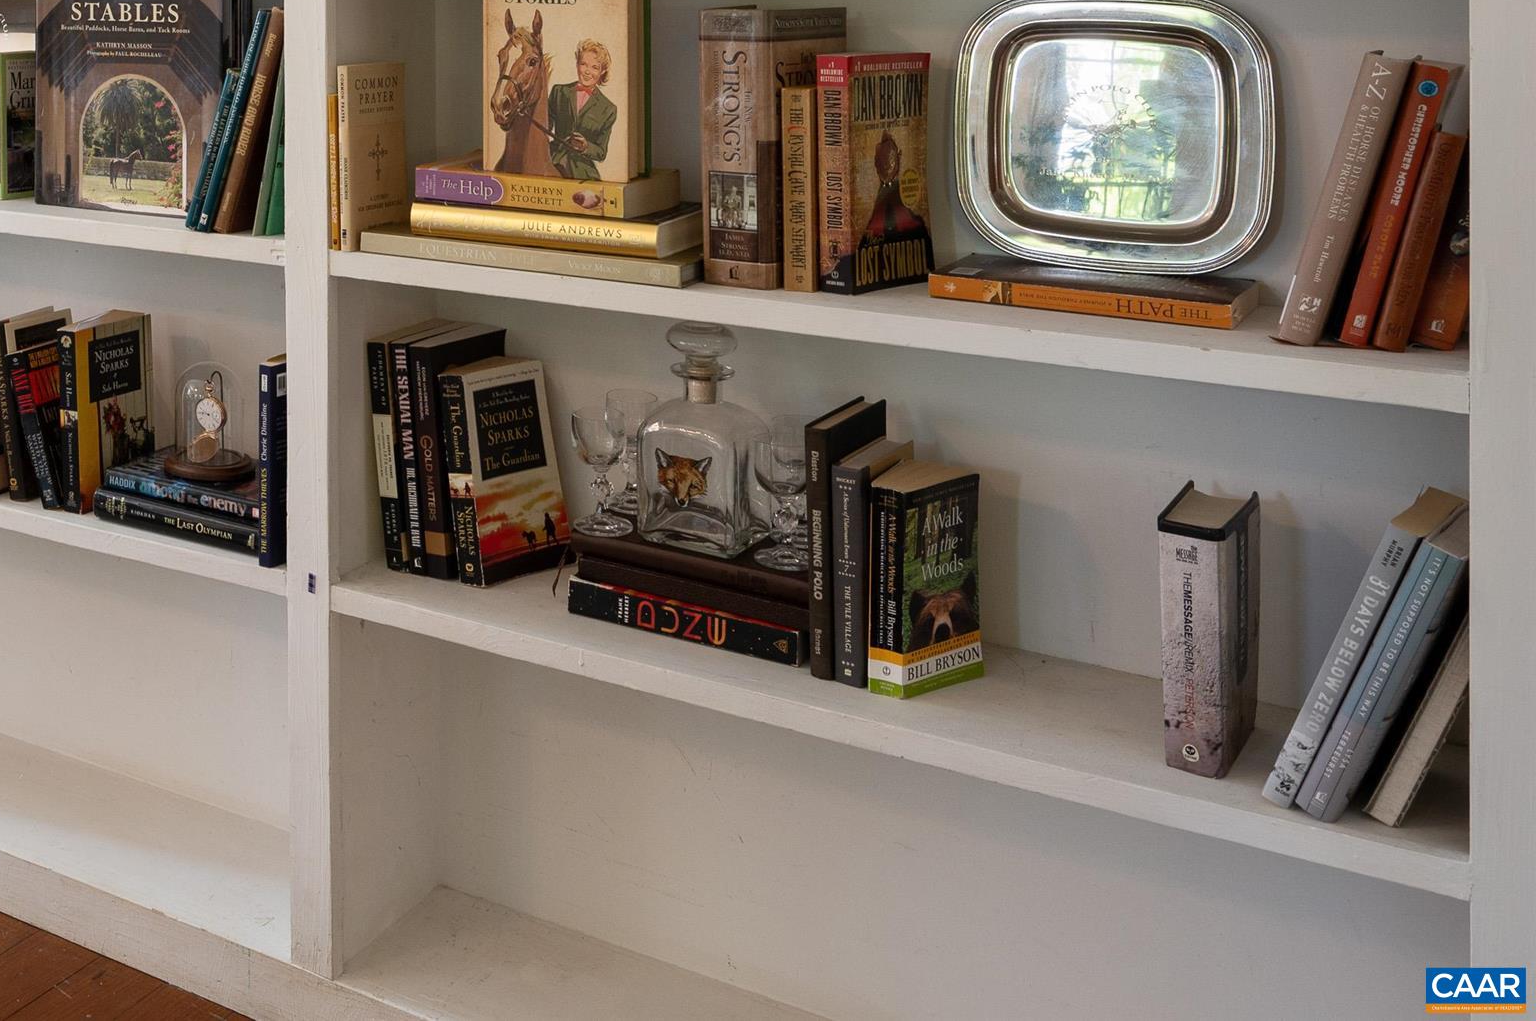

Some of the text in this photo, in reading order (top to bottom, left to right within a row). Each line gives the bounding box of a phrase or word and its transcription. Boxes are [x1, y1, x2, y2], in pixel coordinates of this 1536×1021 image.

[71, 2, 180, 23] STABLES
[354, 75, 398, 92] COMMON
[819, 75, 844, 83] BESTSELLER
[358, 91, 395, 105] PRAYER
[721, 50, 748, 166] STRONG'S
[853, 73, 924, 122] DAN BROWN
[824, 90, 842, 148] DAN BROWN
[1339, 61, 1392, 223] A-Z OF HORSE DISEASES
[1390, 104, 1428, 207] CHRISTOPHER MOORE
[441, 178, 494, 201] The Help
[510, 184, 564, 197] KATHRYN
[510, 194, 564, 207] STOCKETT
[826, 171, 844, 230] LOST SYMBOL
[521, 219, 623, 240] JULIE ANDREWS
[856, 241, 929, 288] LOST SYMBOL
[95, 345, 135, 366] NICHOLAS
[99, 358, 129, 375] SPARKS
[395, 348, 414, 460] THE SEXUAL MAN
[479, 405, 534, 428] NICHOLAS
[487, 425, 530, 448] SPARKS
[484, 448, 540, 473] The Guardian
[922, 506, 963, 536] A Walk
[927, 535, 959, 557] in the
[1381, 539, 1404, 568] BRIAN MURPHY
[921, 557, 964, 582] Woods
[907, 644, 981, 681] BILL BRYSON
[1306, 575, 1391, 734] 81 DAYS BELOW ZERO
[1323, 729, 1352, 779] TERKEURST
